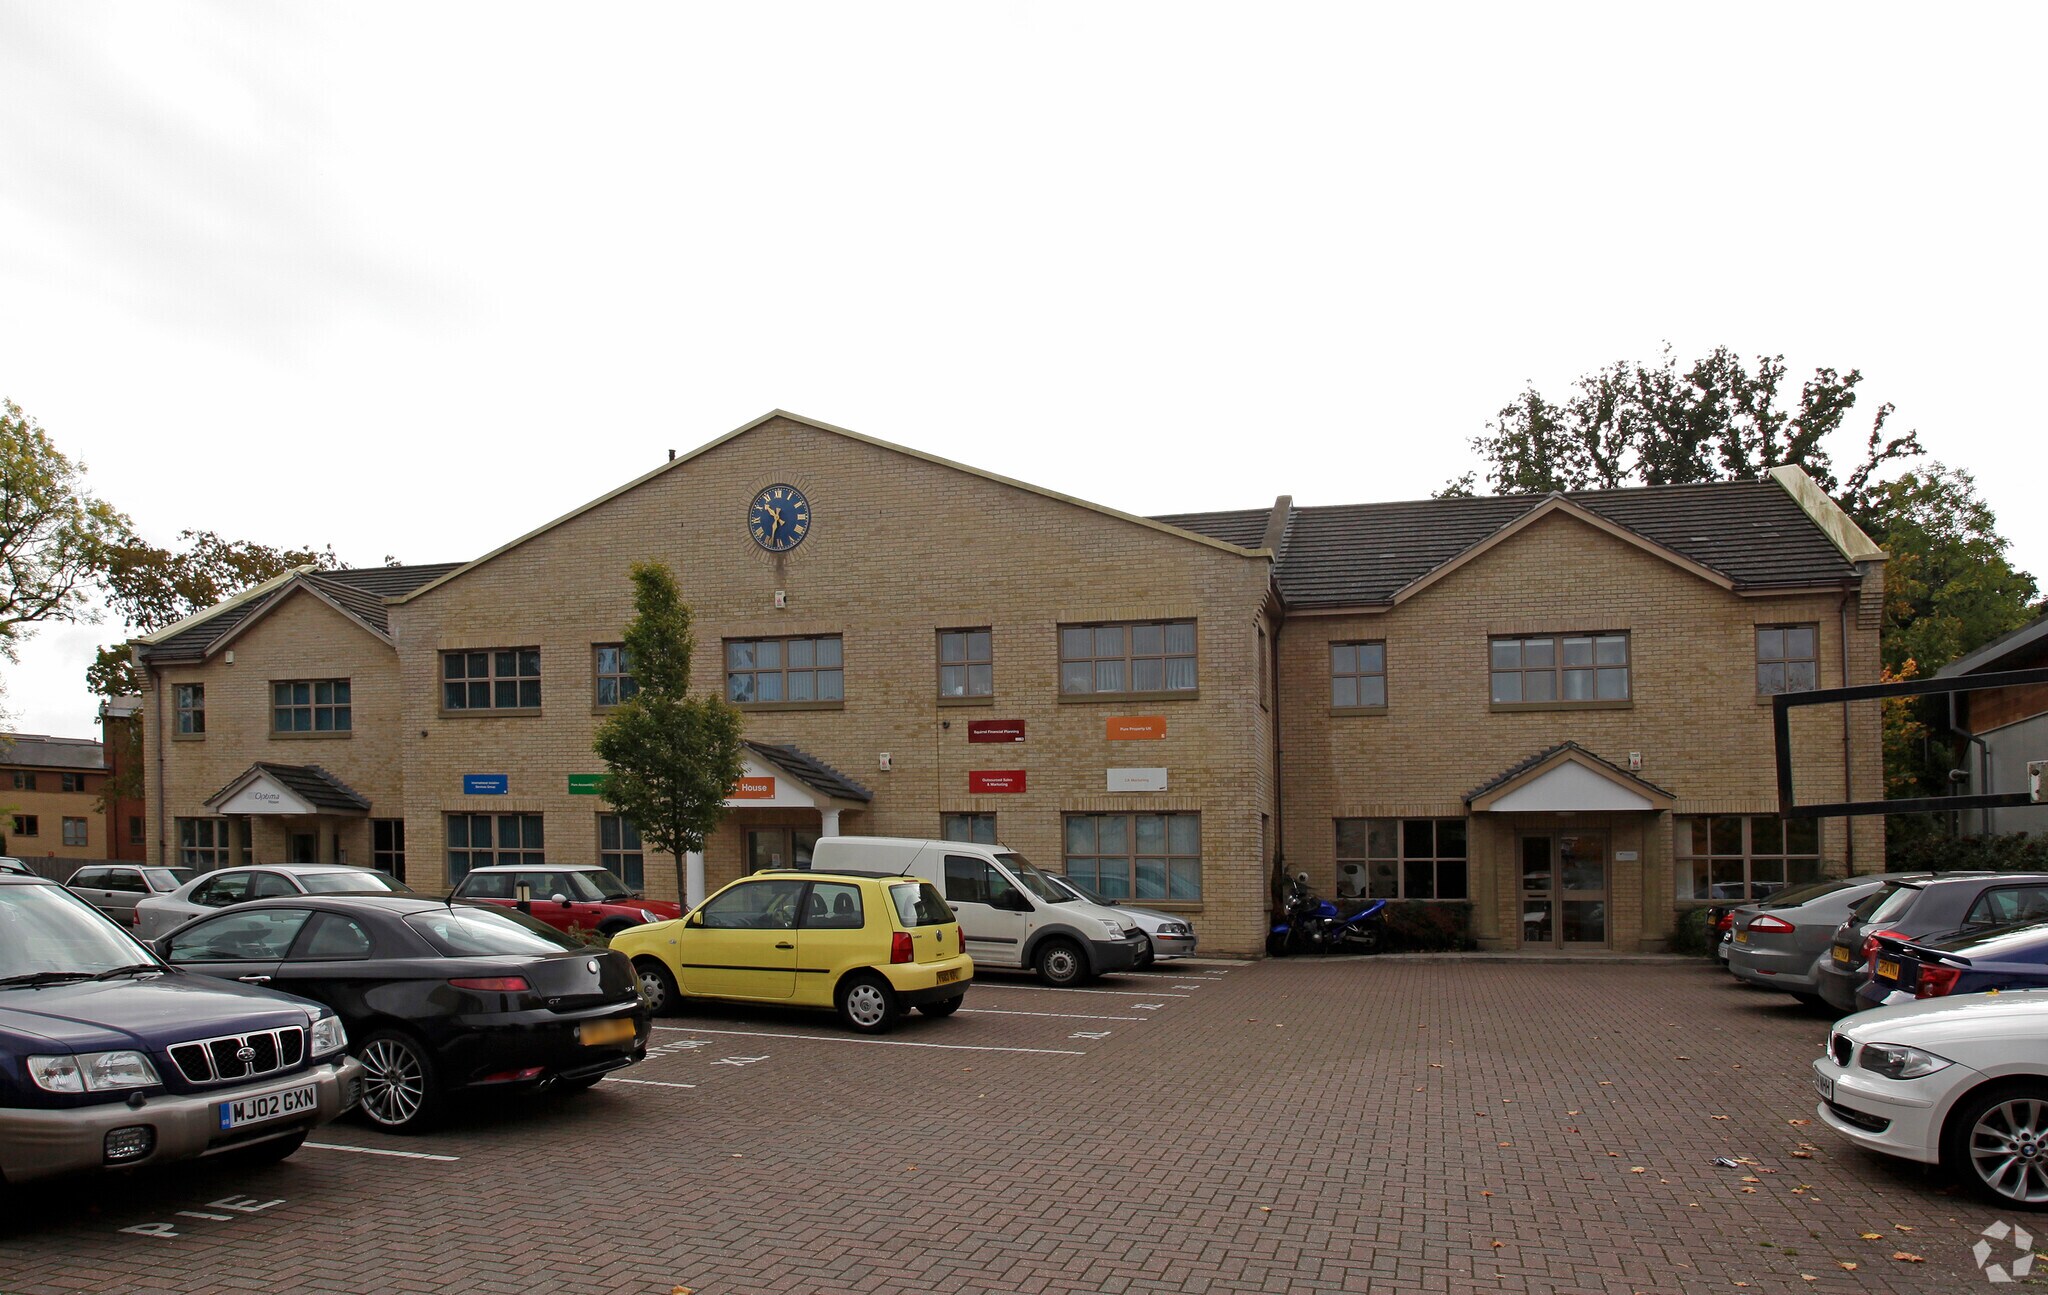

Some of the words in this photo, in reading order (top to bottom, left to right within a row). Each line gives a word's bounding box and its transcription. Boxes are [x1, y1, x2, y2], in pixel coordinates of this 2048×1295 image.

[741, 783, 767, 791] House
[255, 792, 280, 801] Optima
[710, 1055, 770, 1066] XL
[233, 1096, 279, 1123] MJ02
[283, 1087, 315, 1112] GXN
[118, 1194, 287, 1238] PIE
